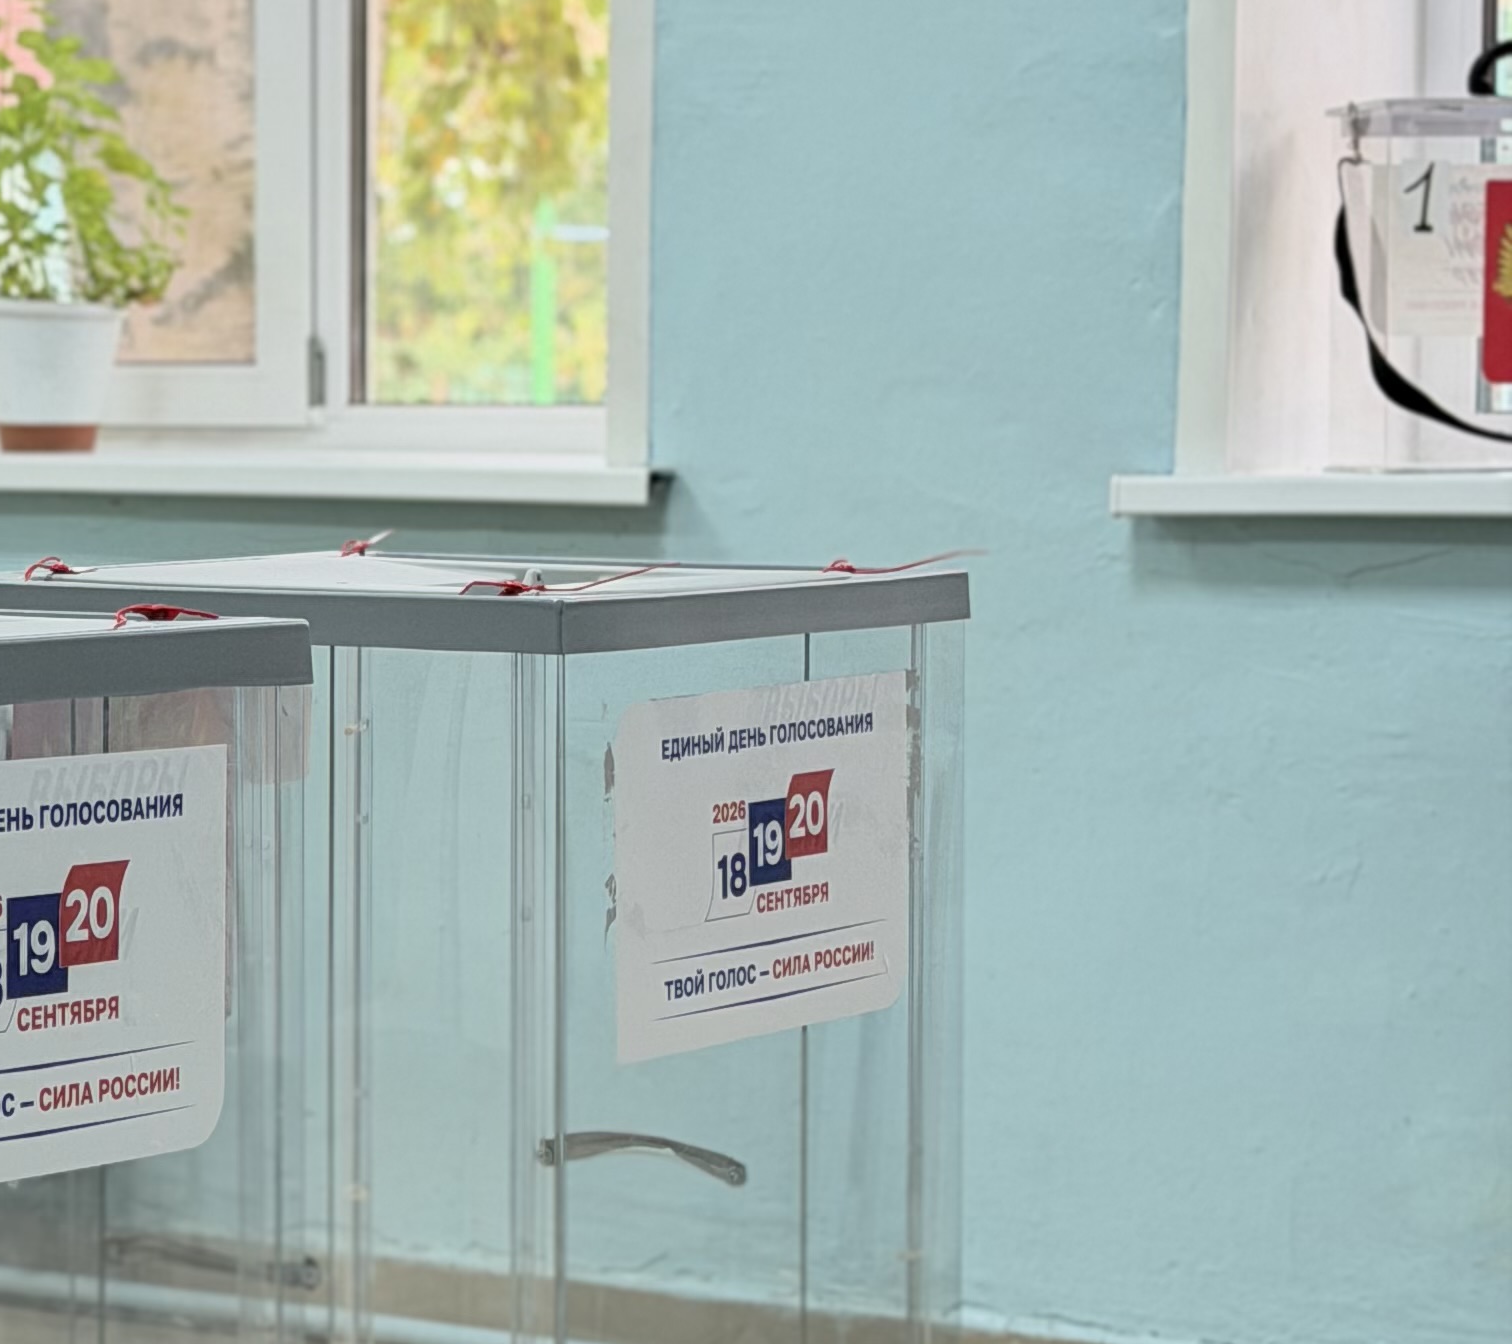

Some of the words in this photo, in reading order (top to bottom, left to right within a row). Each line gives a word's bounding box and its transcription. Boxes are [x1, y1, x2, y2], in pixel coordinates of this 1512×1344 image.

[1404, 162, 1434, 233] 1
[661, 726, 725, 763] ЕДИНЫЙ
[728, 727, 767, 754] ДЕНЬ
[769, 712, 874, 746] ГОЛОСОВАНИЯ
[39, 793, 184, 830] ГОЛОСОВАНИЯ
[712, 799, 747, 824] 2026
[717, 852, 748, 900] 18
[753, 820, 783, 867] 19
[788, 790, 825, 839] 20
[756, 881, 829, 914] СЕНТЯБРЯ
[13, 919, 56, 976] 19
[65, 885, 115, 943] 20
[664, 969, 705, 1001] ТВОЙ
[708, 963, 757, 993] ГОЛОС
[772, 953, 811, 980] СИЛА
[814, 941, 874, 972] РОССИИ!
[17, 995, 120, 1032] СЕНТЯБРЯ
[39, 1082, 94, 1112] СИЛА
[98, 1066, 181, 1103] РОССИИ!
